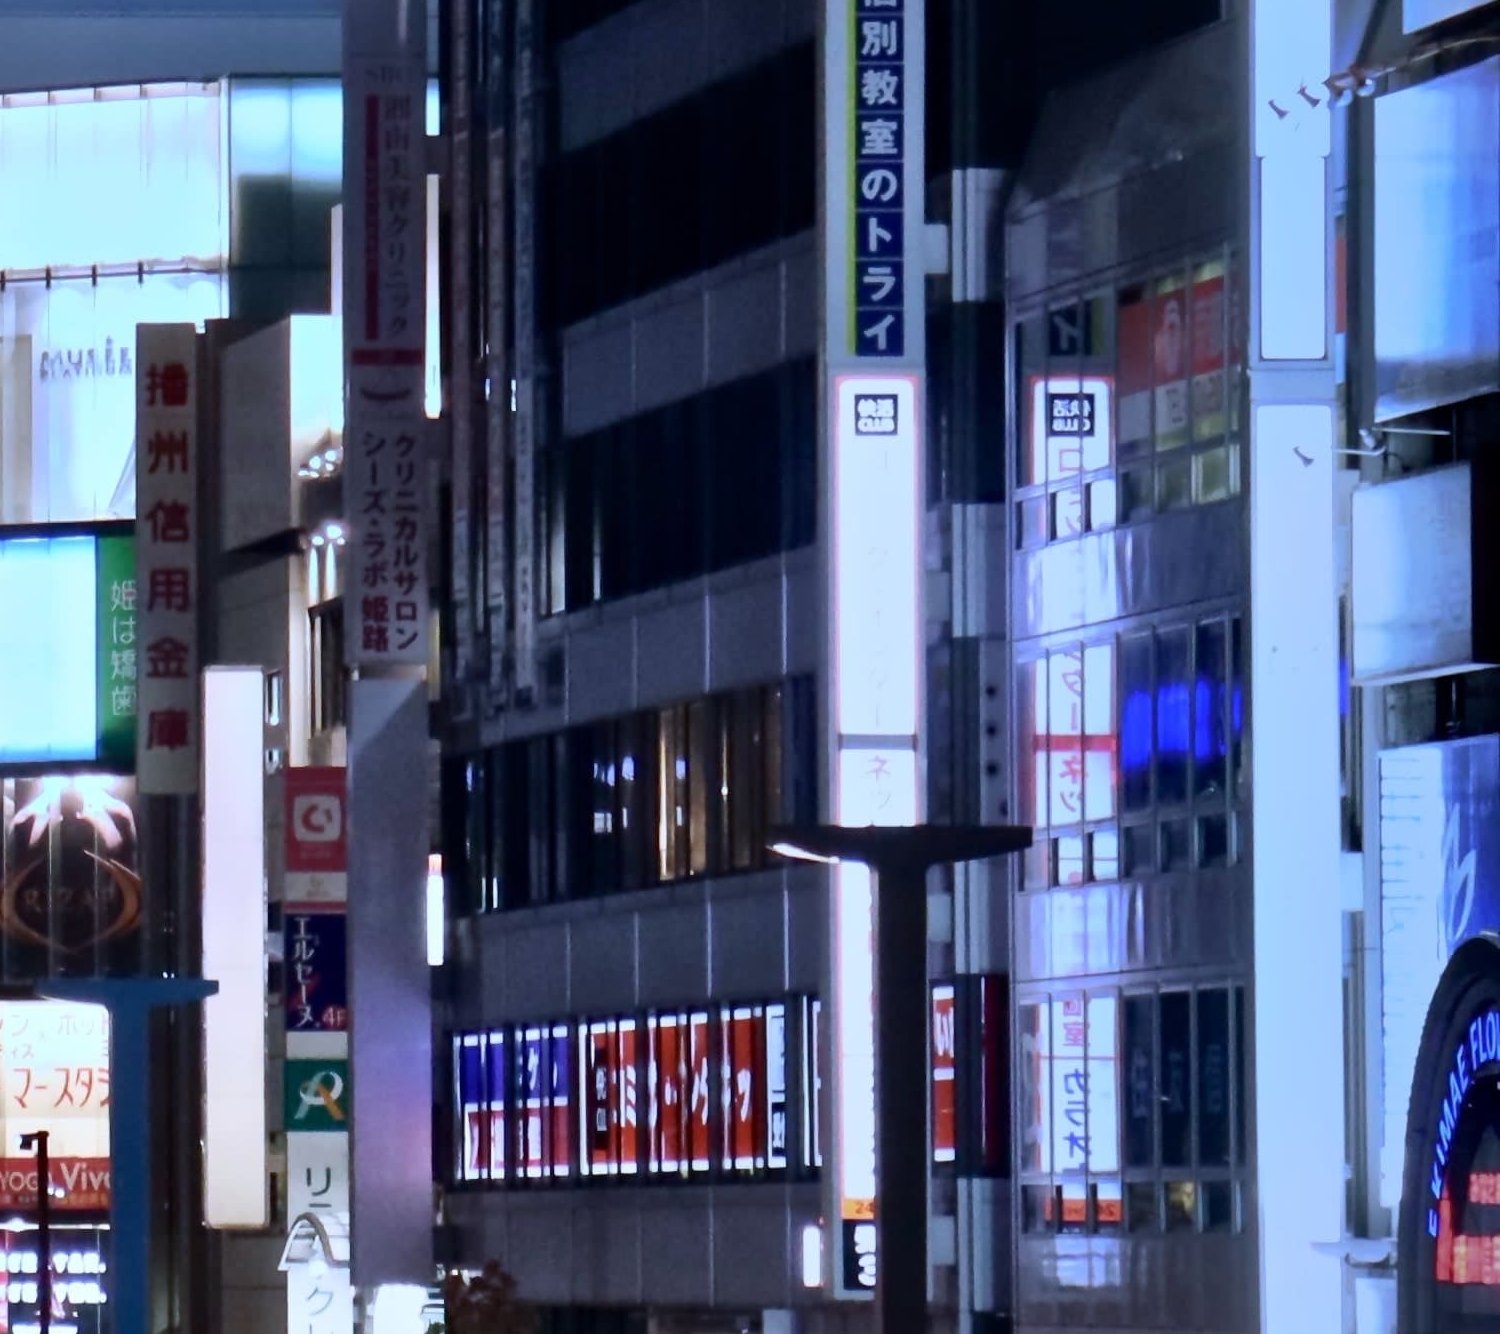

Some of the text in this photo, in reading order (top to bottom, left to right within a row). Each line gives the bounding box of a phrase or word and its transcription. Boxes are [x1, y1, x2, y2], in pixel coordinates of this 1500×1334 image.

[144, 363, 190, 753] 播州信用金庫
[394, 434, 419, 651] クリニカルサロン
[293, 917, 316, 1028] エルセーヌ
